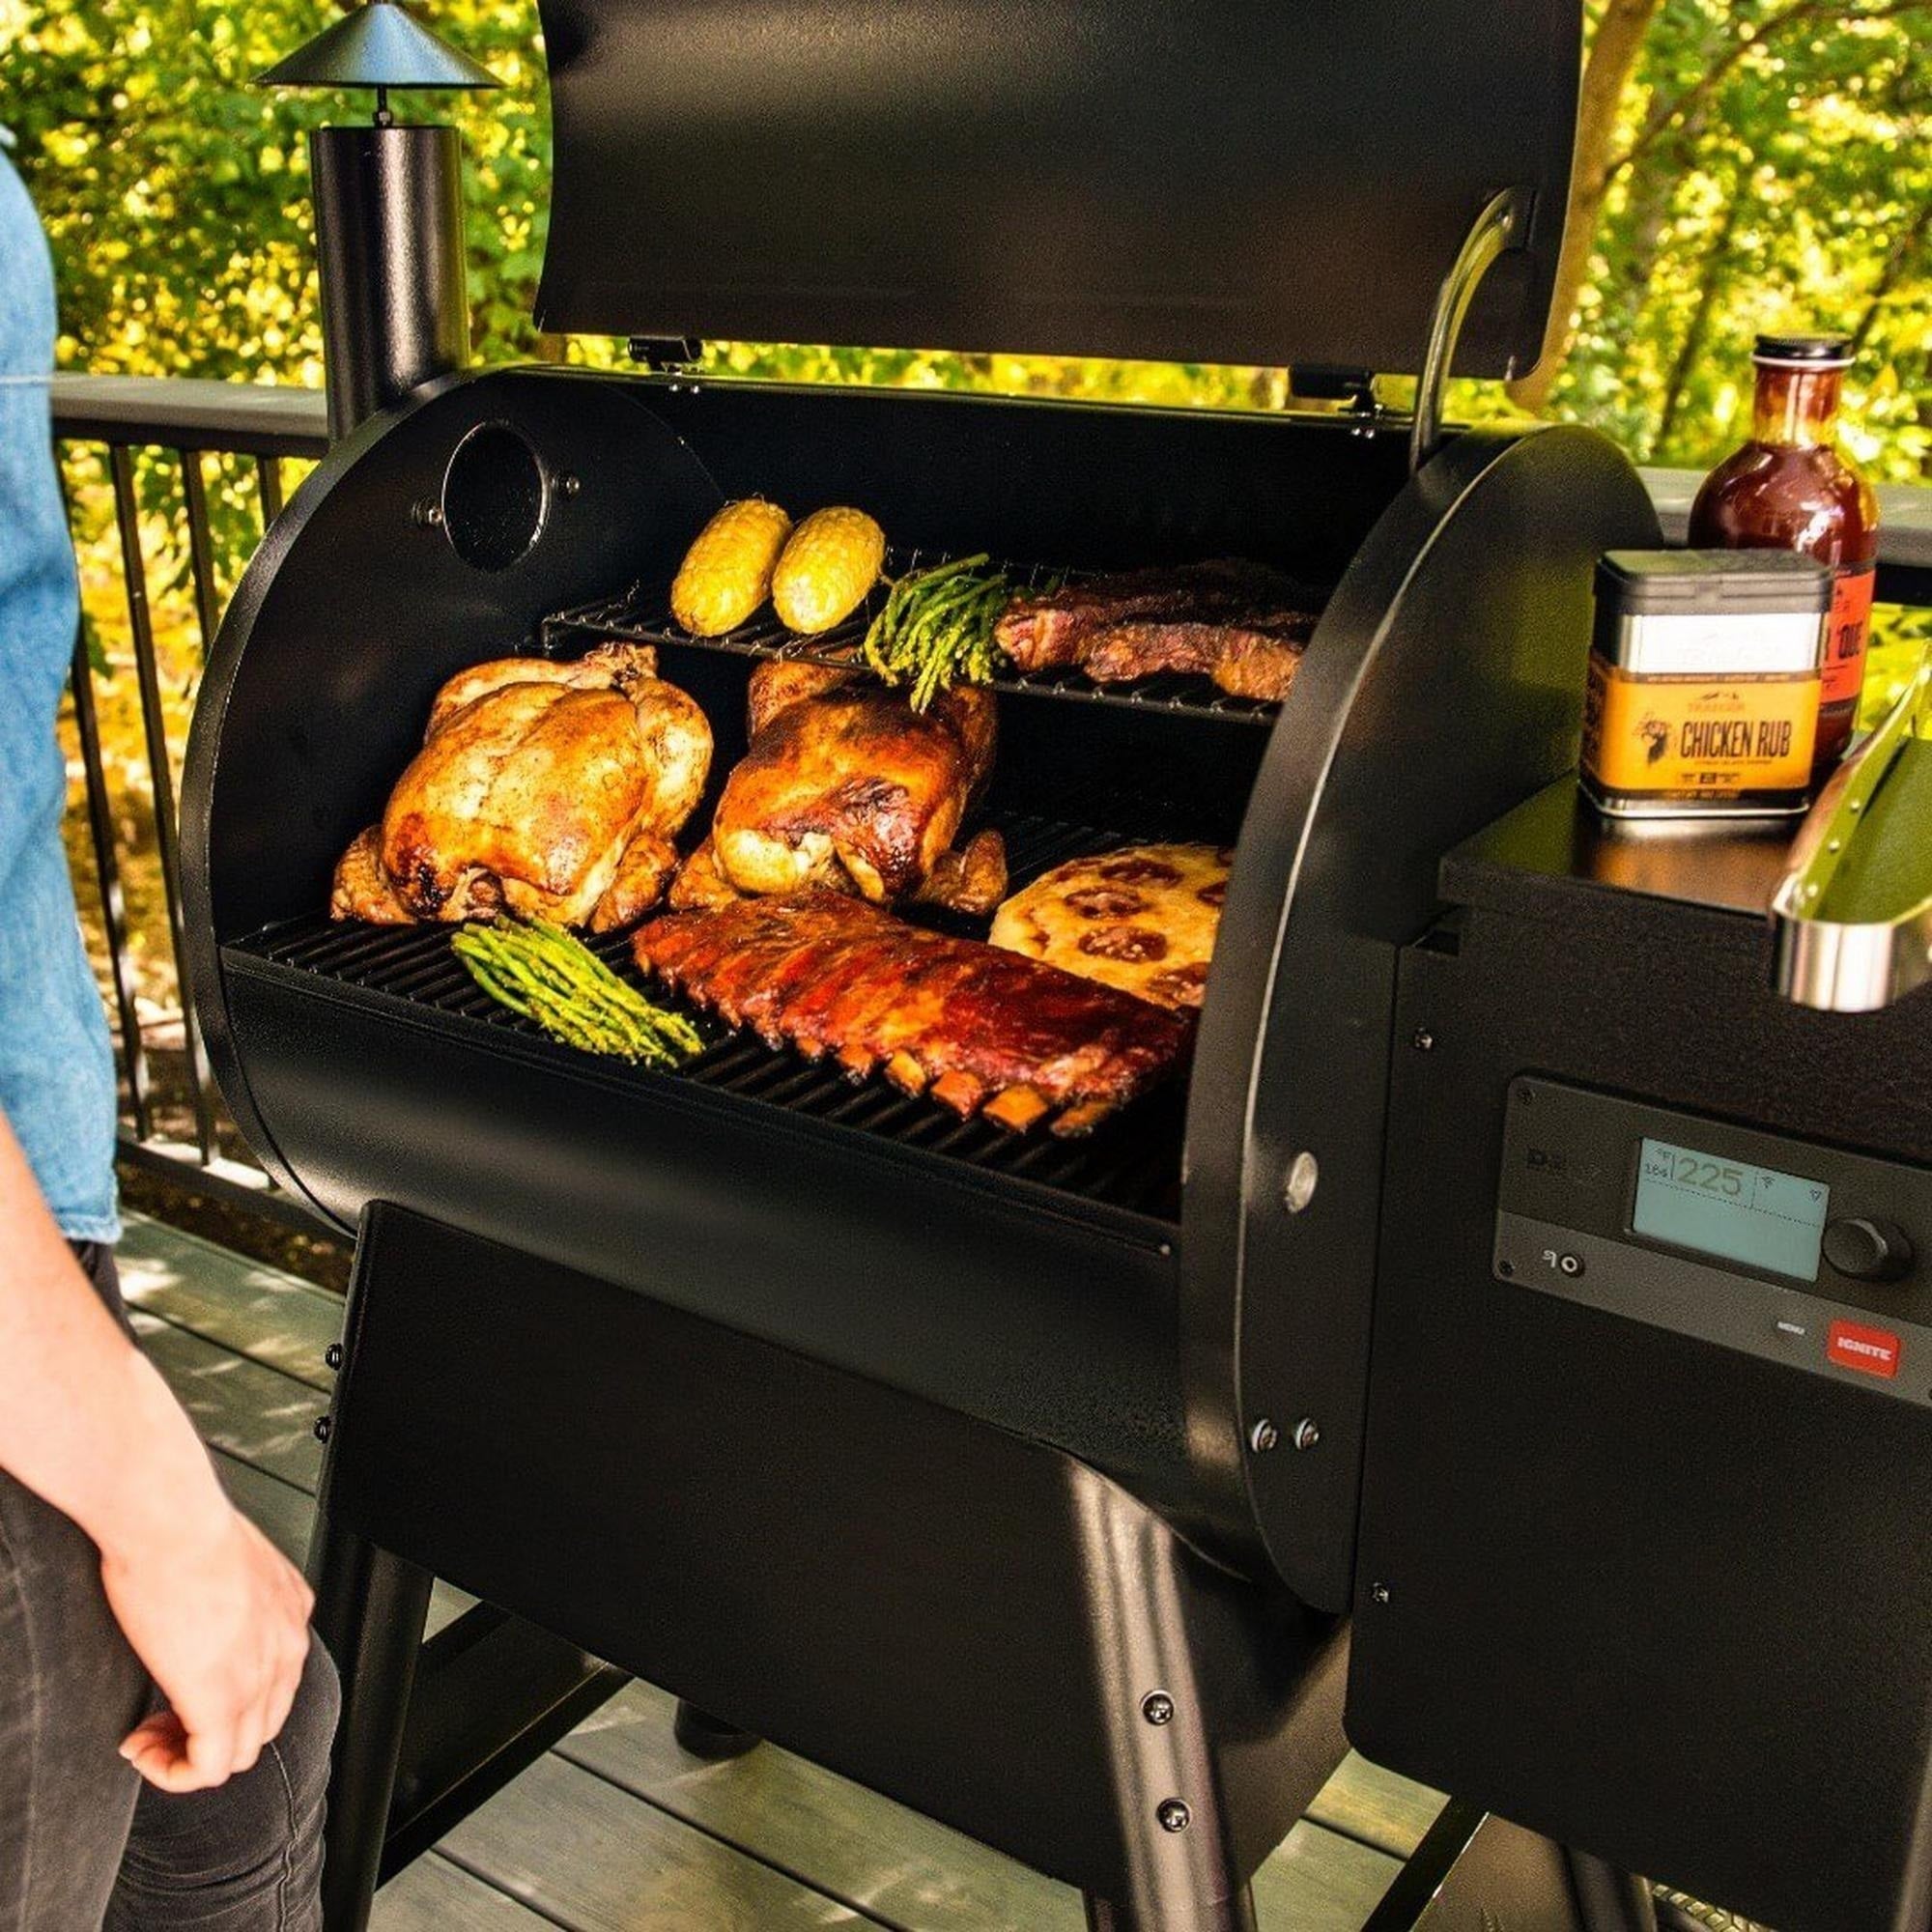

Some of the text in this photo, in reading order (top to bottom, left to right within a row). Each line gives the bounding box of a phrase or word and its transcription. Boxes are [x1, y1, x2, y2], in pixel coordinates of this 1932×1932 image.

[1681, 721, 1792, 757] CHICKEN RUB
[1679, 1157, 1743, 1195] 225
[1837, 1337, 1891, 1361] IGNITE
